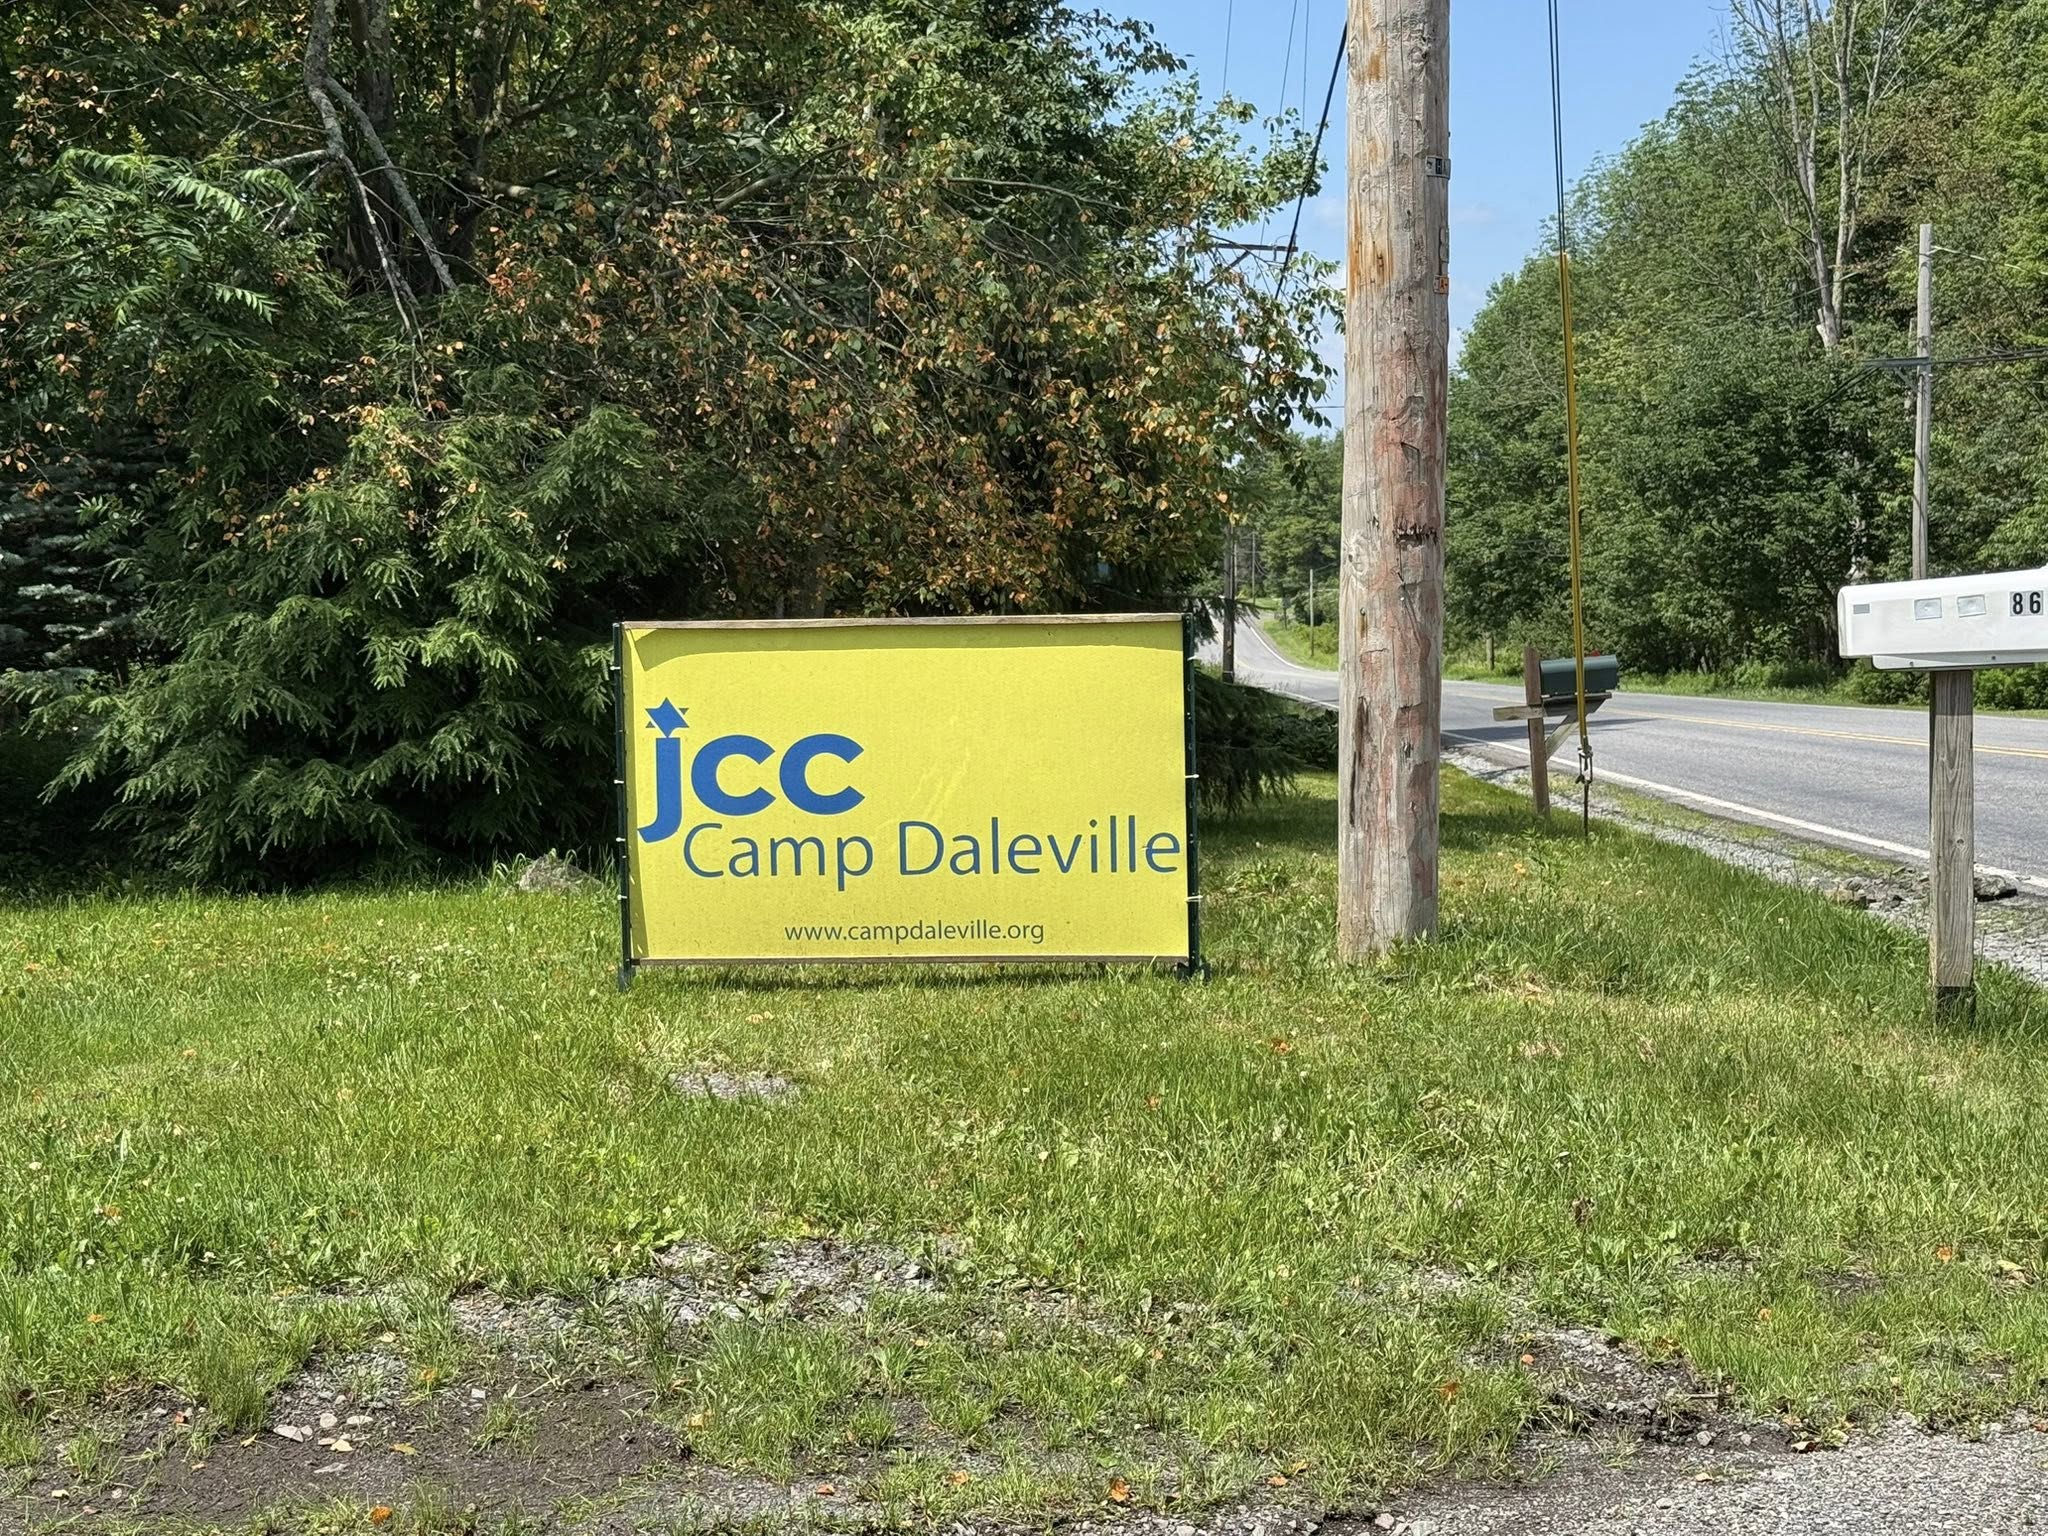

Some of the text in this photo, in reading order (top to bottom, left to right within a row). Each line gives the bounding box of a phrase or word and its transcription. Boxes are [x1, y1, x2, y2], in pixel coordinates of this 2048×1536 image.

[2013, 592, 2041, 615] 86
[638, 697, 865, 843] jcc
[683, 816, 1181, 891] Camp Daleville
[784, 919, 1045, 945] www.campdaleville.org
